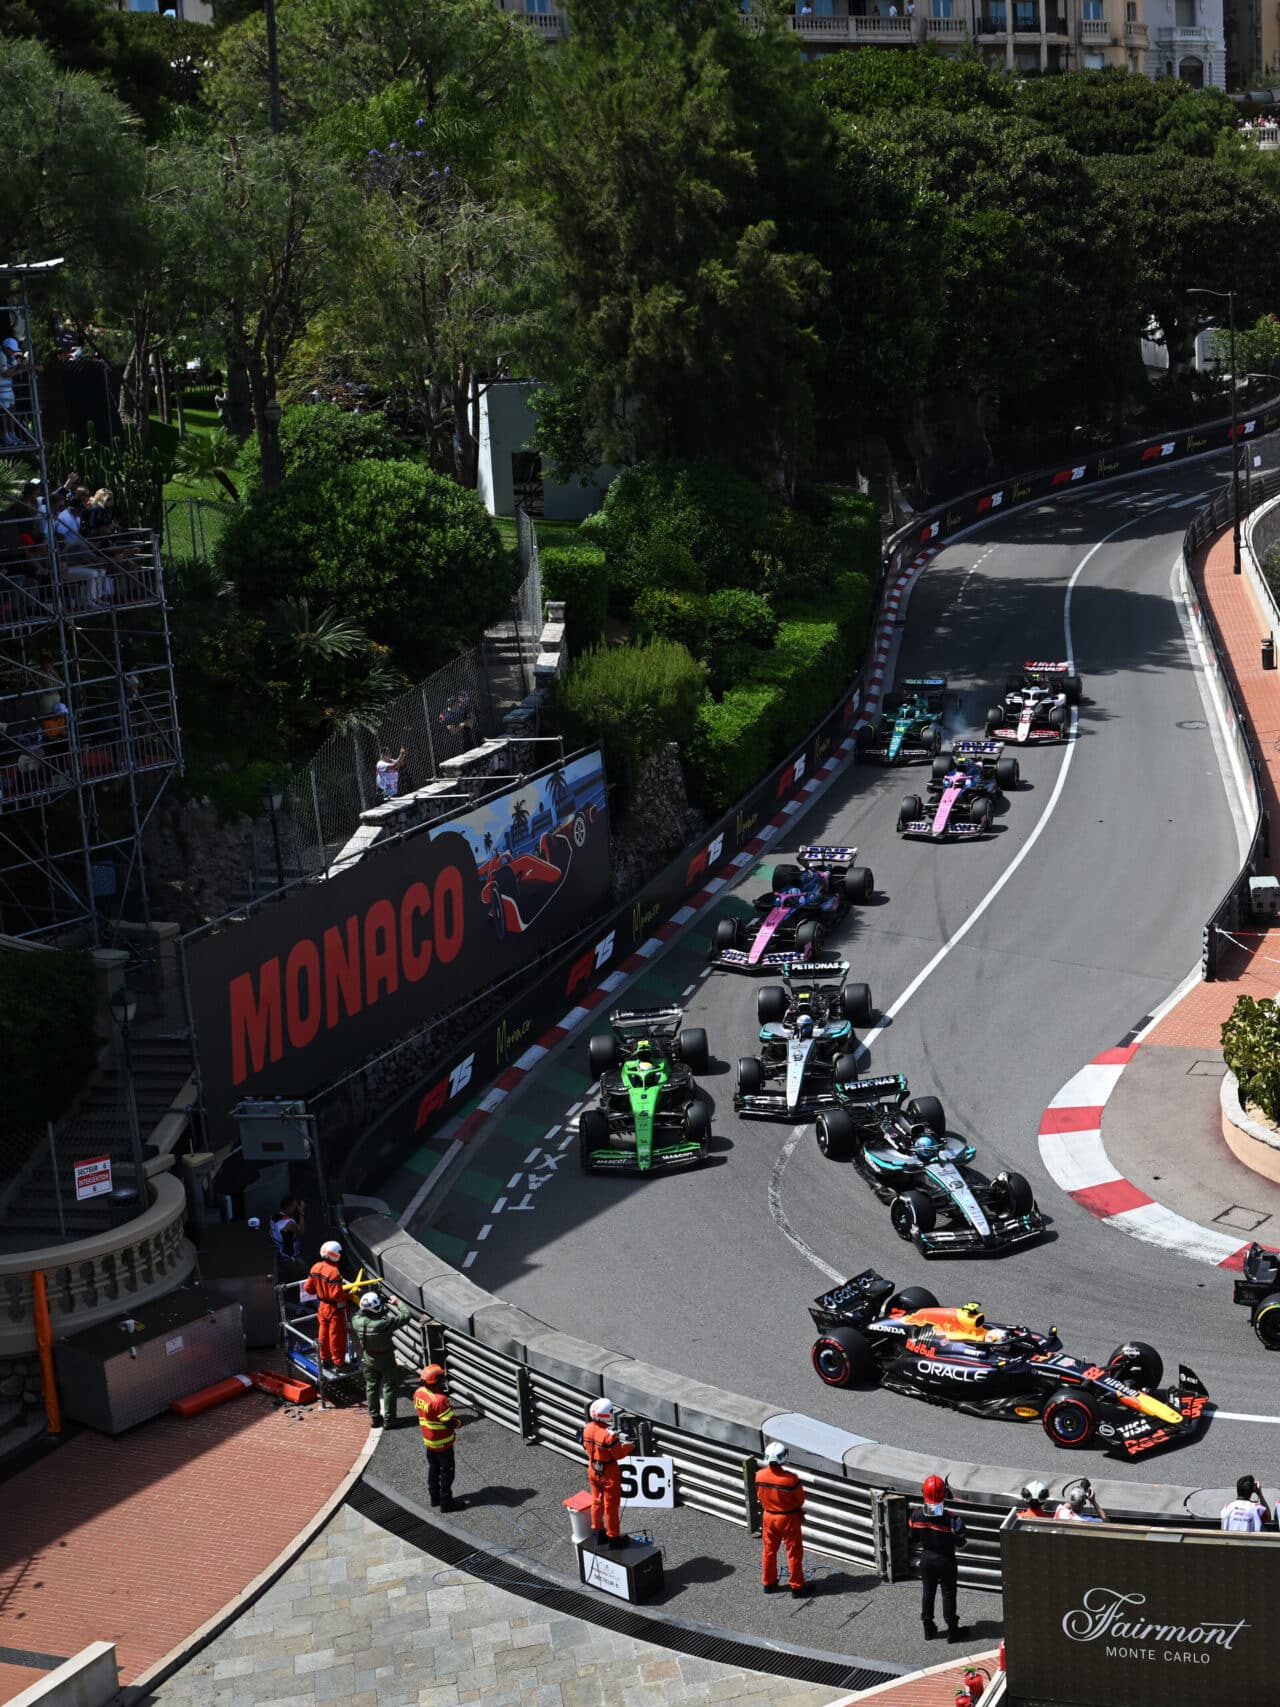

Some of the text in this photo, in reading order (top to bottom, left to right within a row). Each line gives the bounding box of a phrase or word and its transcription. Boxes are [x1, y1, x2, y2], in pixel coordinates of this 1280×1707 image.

[228, 865, 464, 1086] MONACO
[792, 962, 839, 971] PETRONAS
[496, 1019, 533, 1065] Monaco
[844, 1076, 895, 1090] PETRONAS
[868, 1324, 906, 1336] HONDA
[917, 1360, 988, 1383] ORACLE
[1124, 1429, 1170, 1455] Red
[620, 1464, 665, 1500] SC
[1062, 1587, 1251, 1650] Fairmont
[1106, 1646, 1210, 1664] MONTE CARLO
